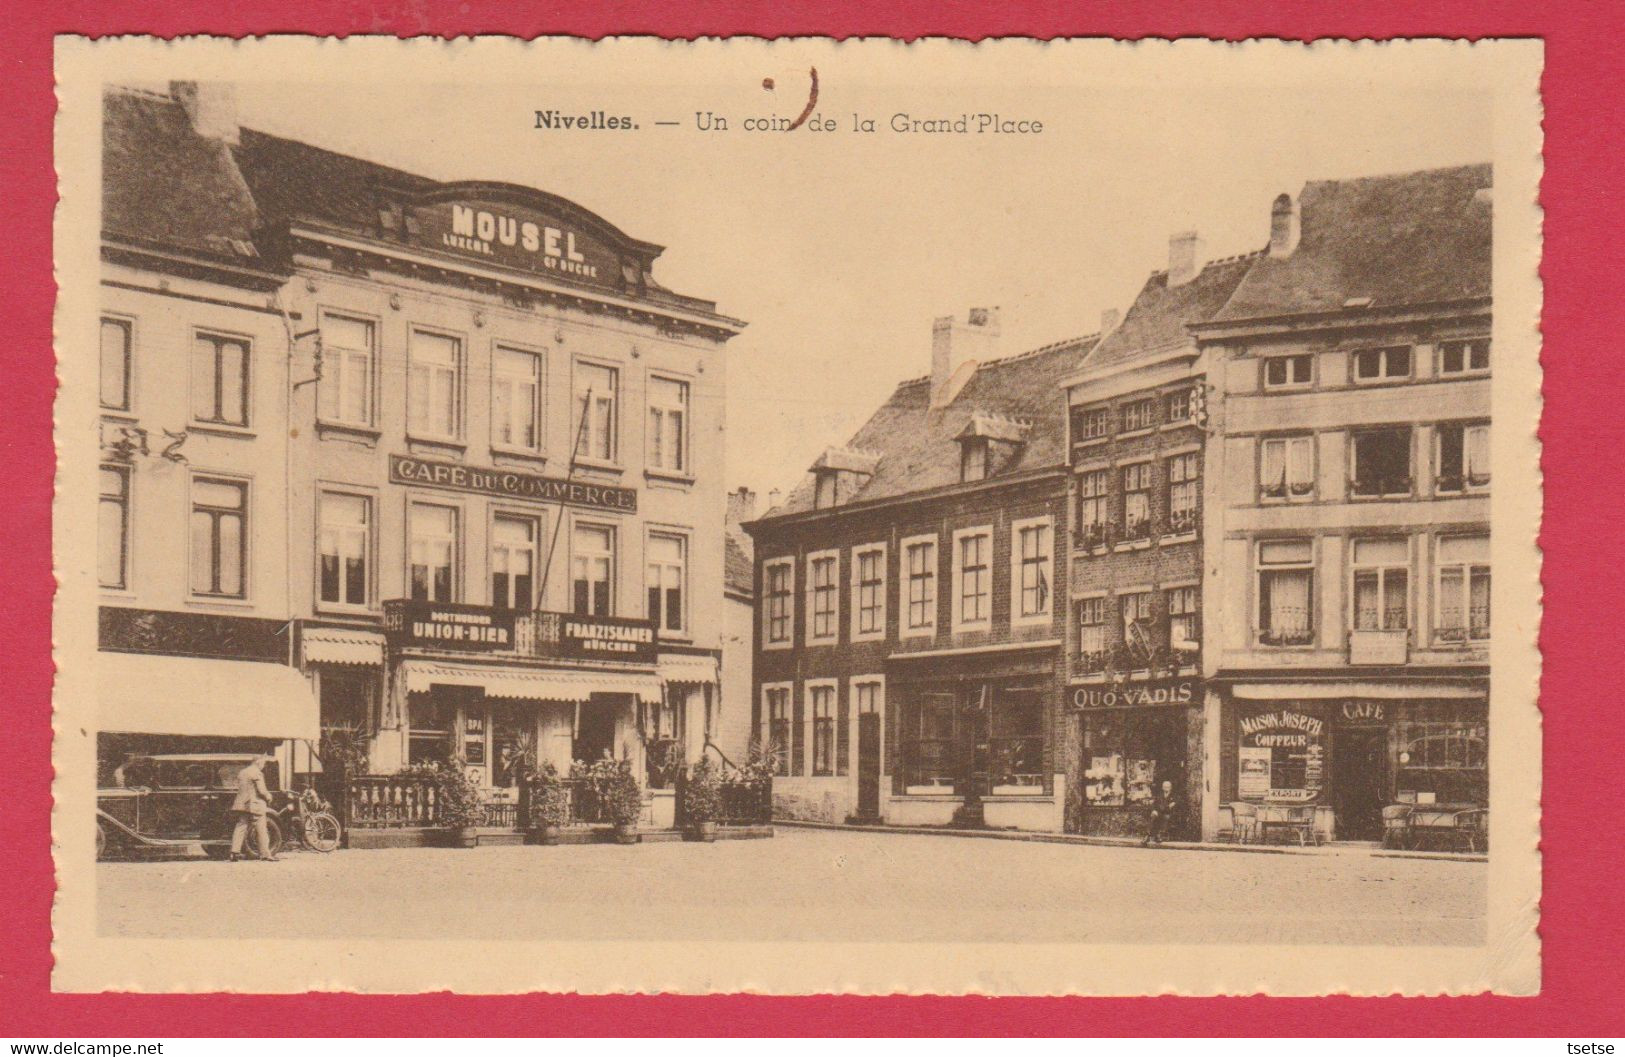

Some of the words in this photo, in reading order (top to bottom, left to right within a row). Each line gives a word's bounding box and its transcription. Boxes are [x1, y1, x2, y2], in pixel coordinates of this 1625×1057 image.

[534, 111, 641, 131] Nivelles.
[695, 112, 729, 132] Un
[742, 112, 793, 132] coin
[808, 111, 837, 132] de
[853, 112, 876, 133] la
[891, 113, 1044, 135] Grand'Place
[453, 204, 584, 262] MOUSEL
[471, 472, 498, 490] DU
[502, 475, 634, 508] COMMERCE
[413, 622, 508, 643] UNION-BIER
[565, 622, 653, 643] FRANZISKANER
[1239, 711, 1279, 736] MAISON
[1279, 709, 1324, 736] JOSEPH
[1255, 733, 1307, 747] COIFFEUR
